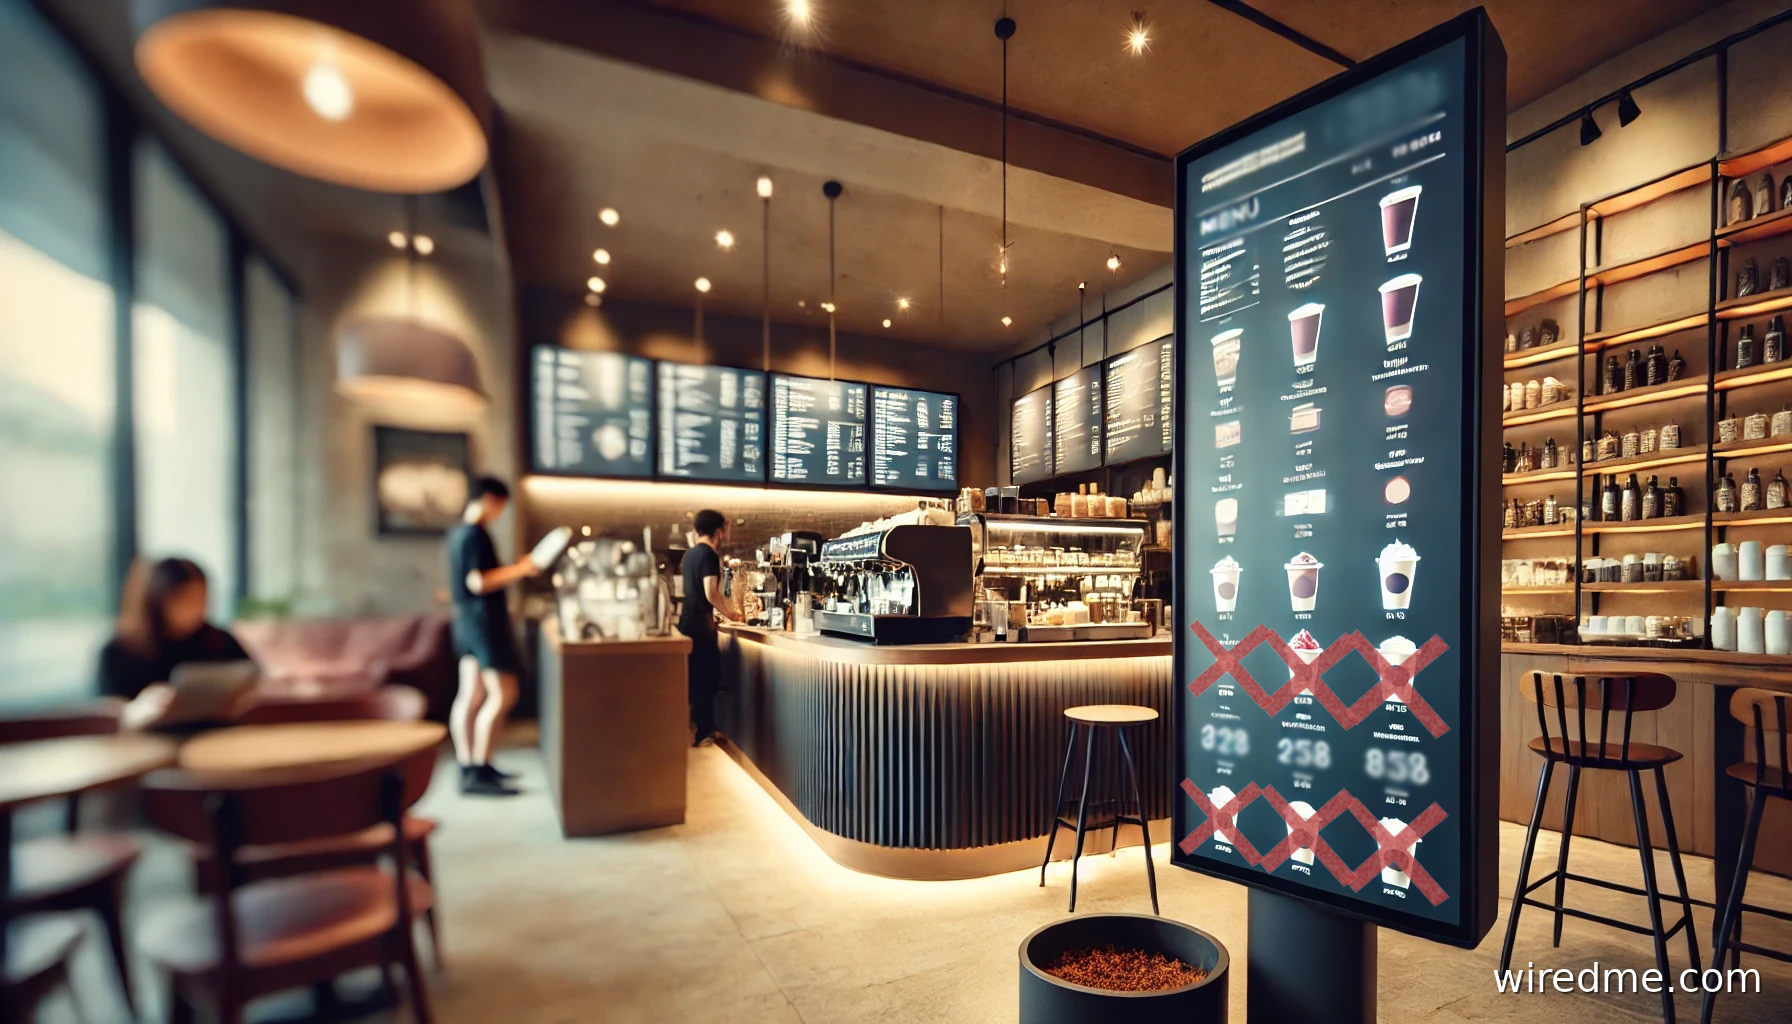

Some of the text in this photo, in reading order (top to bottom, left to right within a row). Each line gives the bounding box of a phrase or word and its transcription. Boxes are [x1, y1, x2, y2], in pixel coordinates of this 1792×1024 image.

[1200, 196, 1260, 236] MENU
[1277, 737, 1331, 769] 258
[1365, 747, 1430, 785] 858
